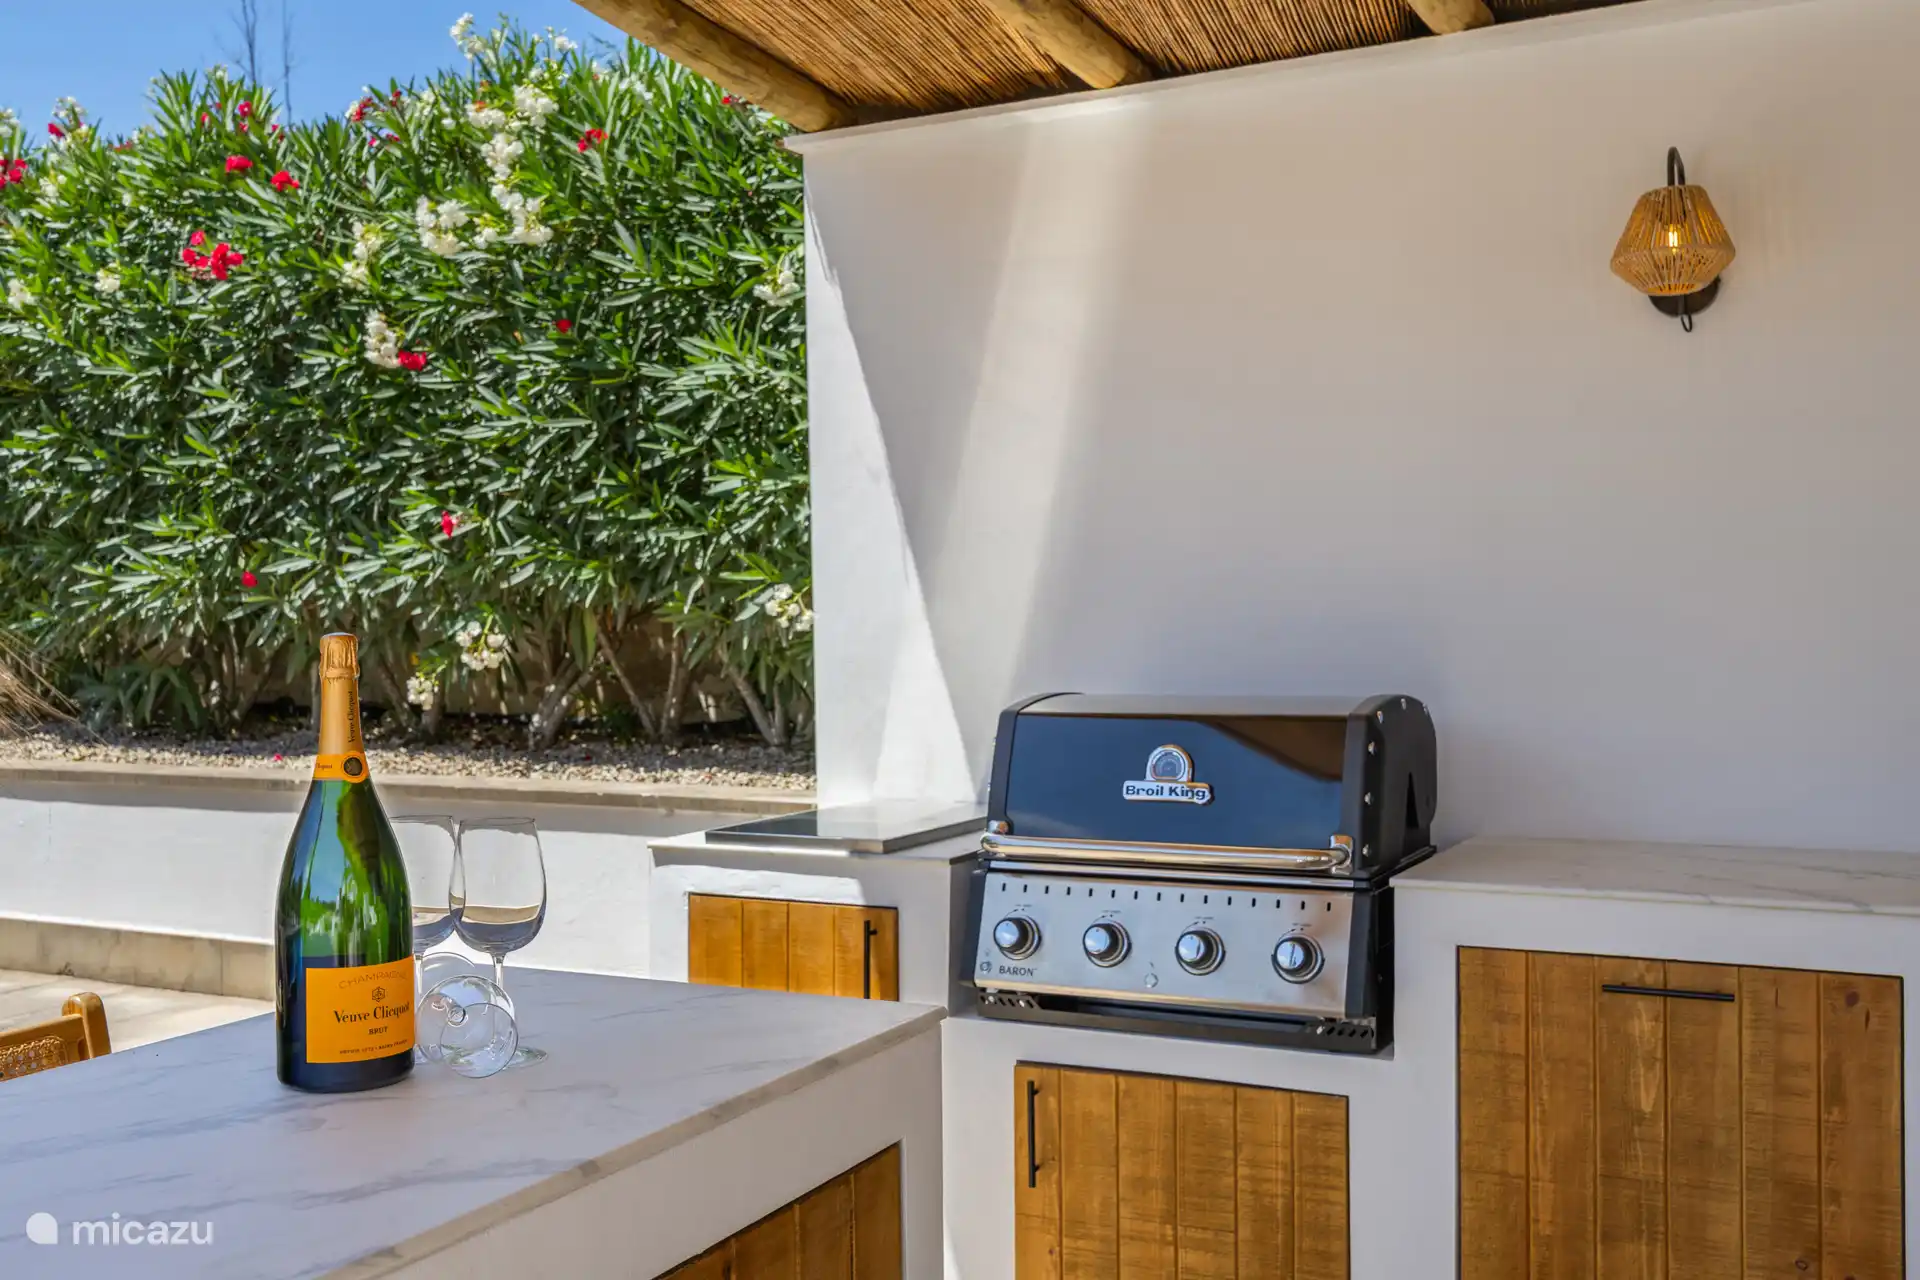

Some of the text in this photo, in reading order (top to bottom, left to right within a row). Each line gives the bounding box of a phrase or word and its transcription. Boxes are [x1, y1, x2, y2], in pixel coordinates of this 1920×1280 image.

[1125, 784, 1207, 801] Broil King
[999, 965, 1034, 977] BARON
[333, 1000, 410, 1024] Veuve Clicquot
[368, 1026, 388, 1035] BRUT
